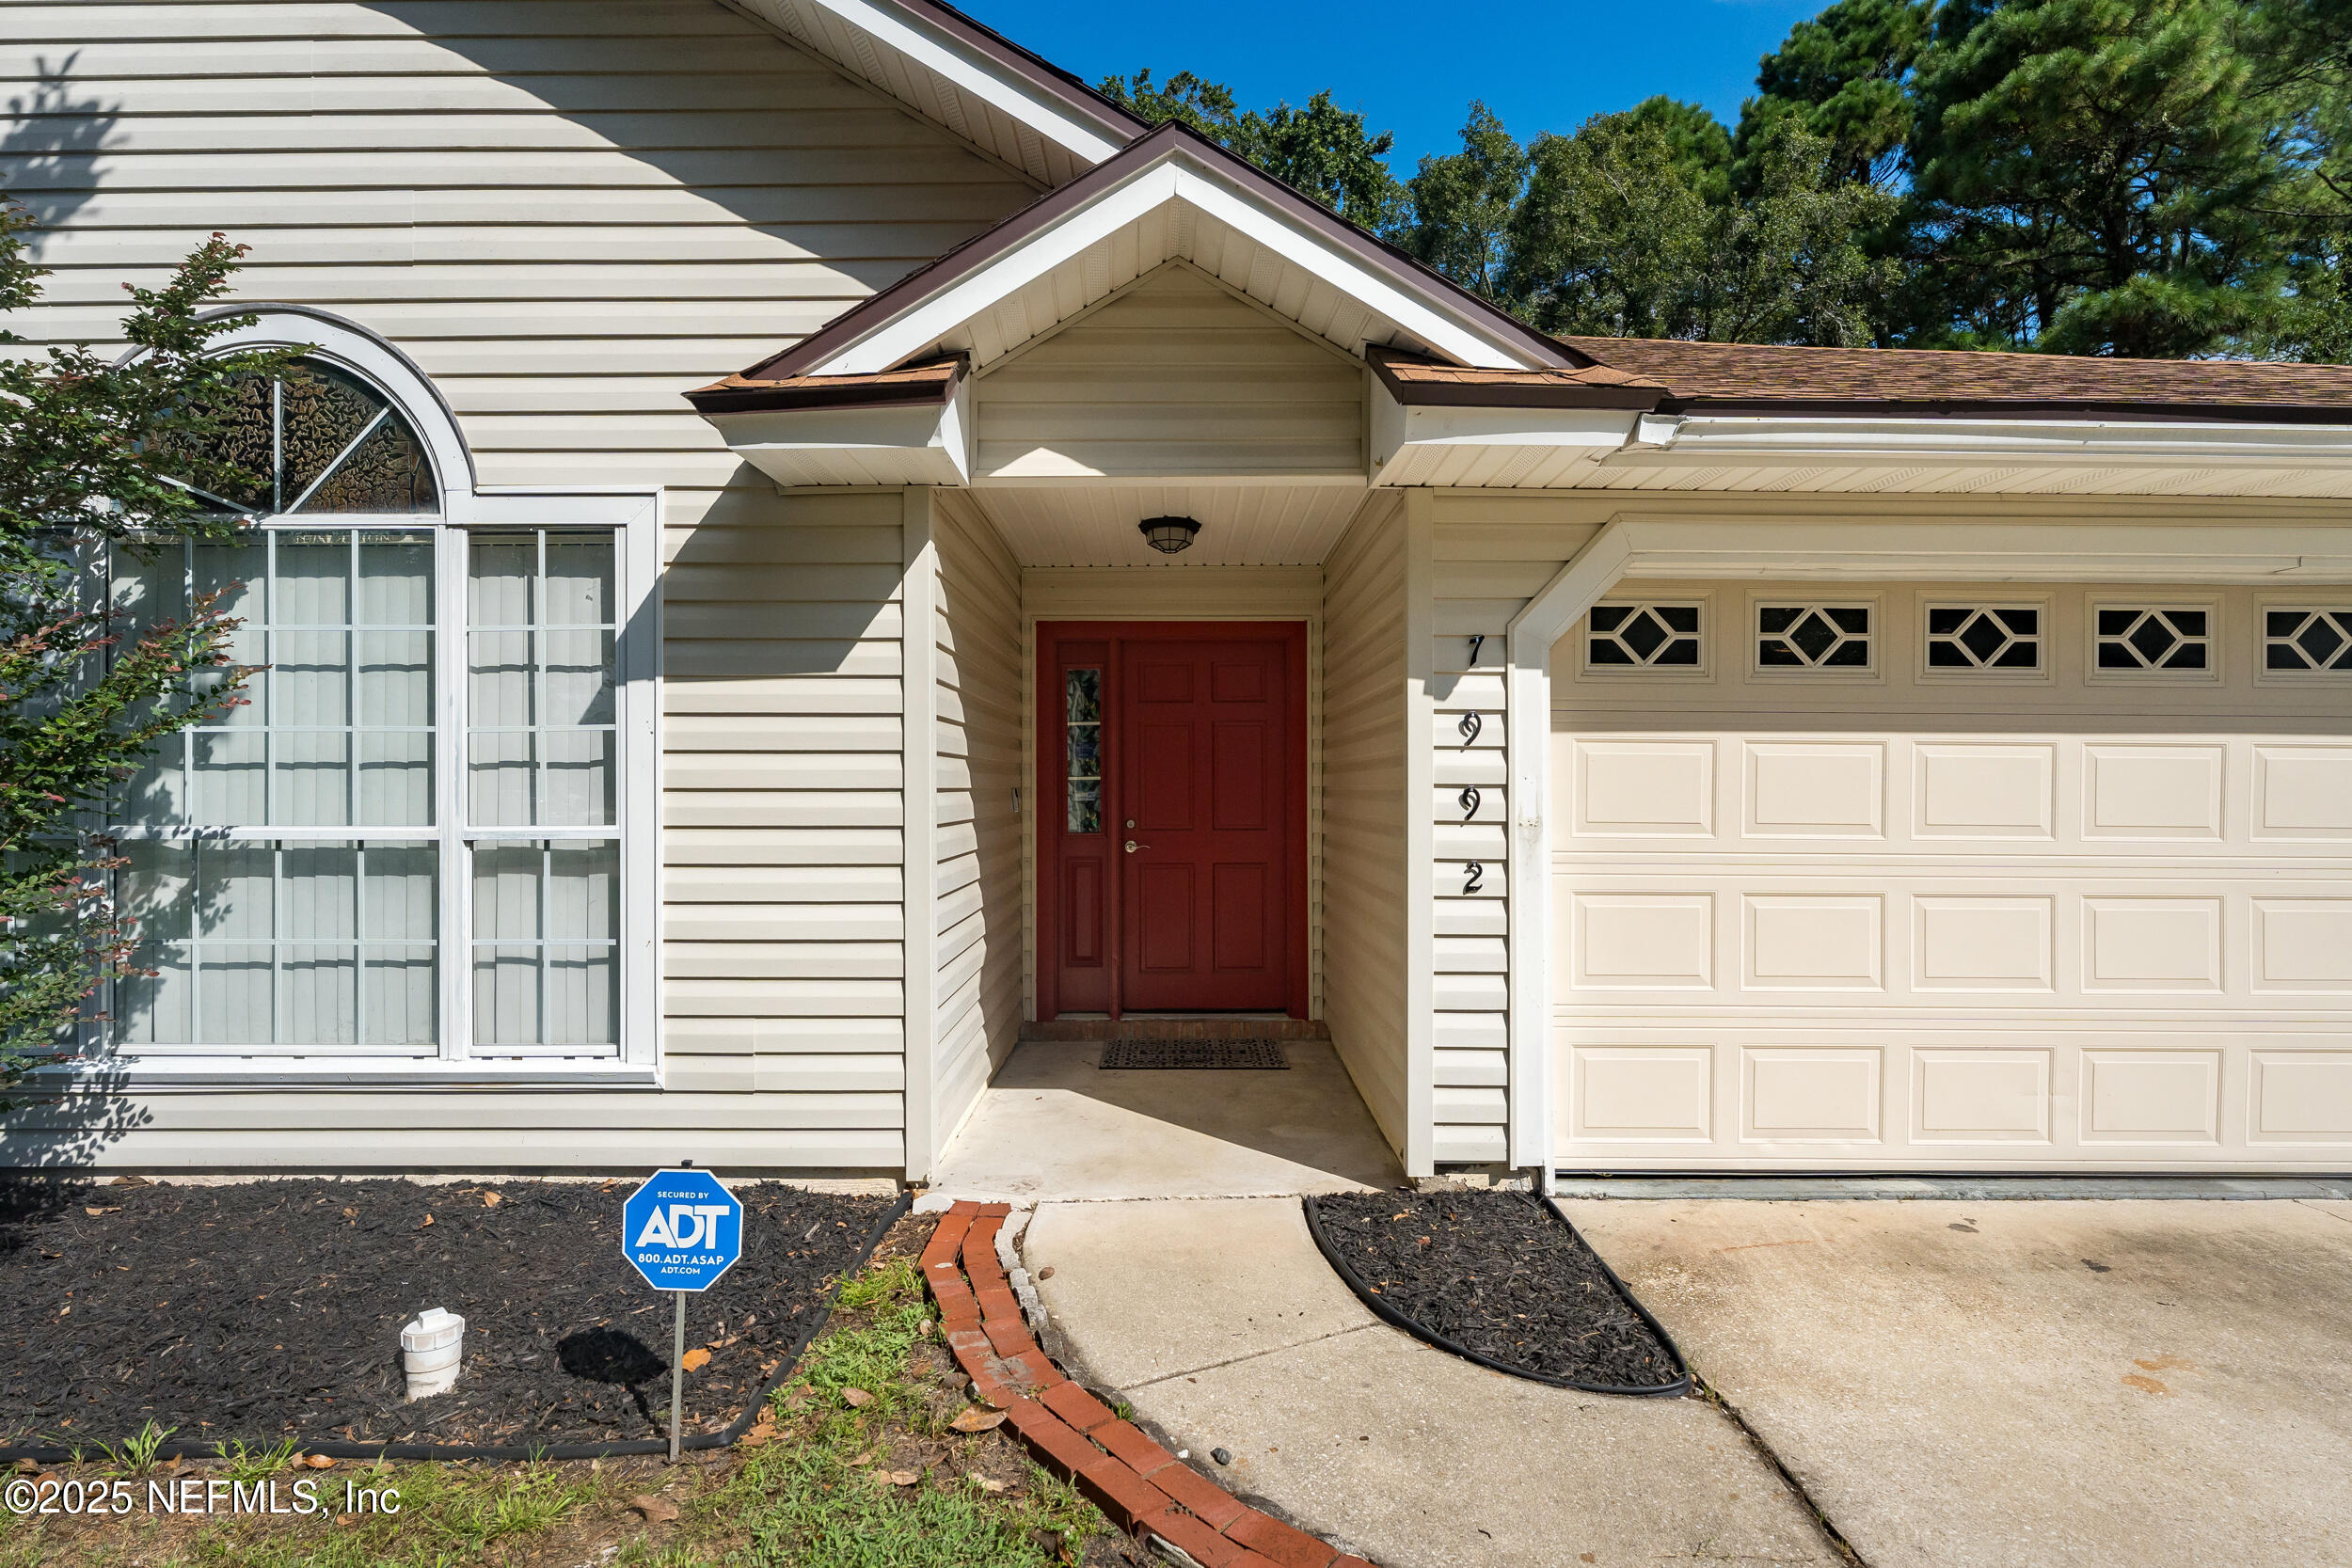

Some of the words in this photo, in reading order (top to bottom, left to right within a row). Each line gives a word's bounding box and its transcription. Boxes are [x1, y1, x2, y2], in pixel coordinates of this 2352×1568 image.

[1463, 634, 1486, 895] 7992
[657, 1191, 696, 1199] SECURED
[634, 1204, 730, 1249] ADT
[638, 1253, 724, 1265] 800.ADT.ASAP
[660, 1266, 701, 1275] ADT.COM
